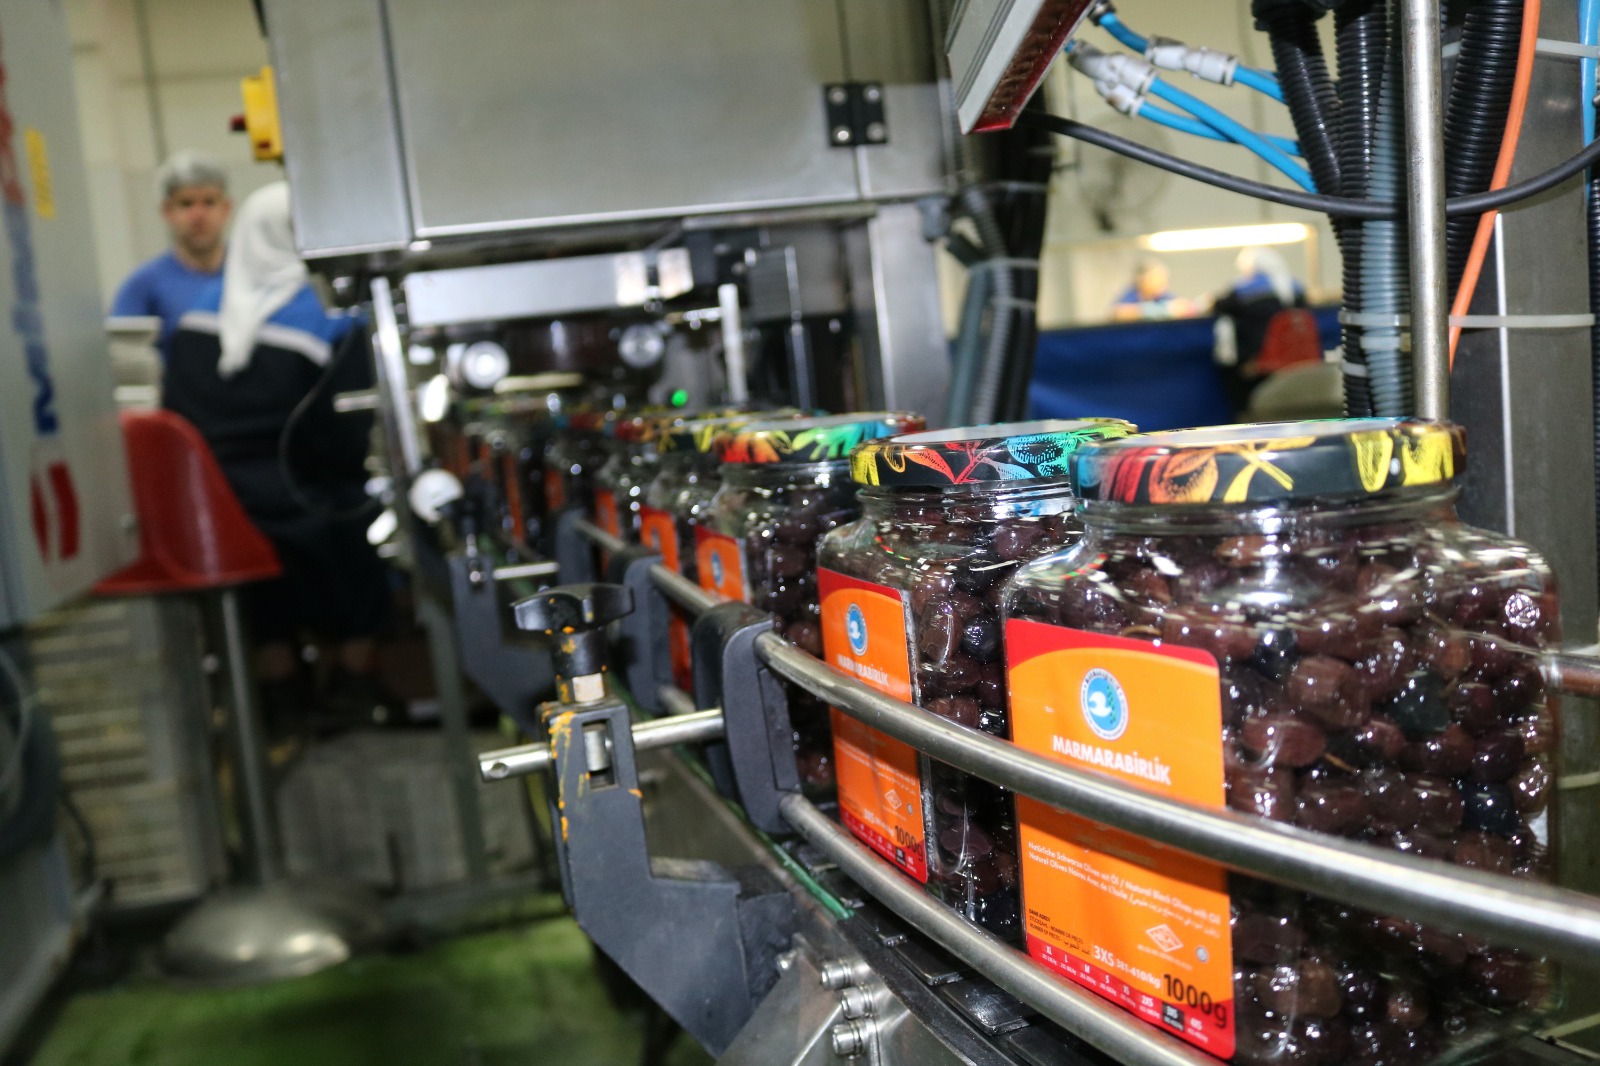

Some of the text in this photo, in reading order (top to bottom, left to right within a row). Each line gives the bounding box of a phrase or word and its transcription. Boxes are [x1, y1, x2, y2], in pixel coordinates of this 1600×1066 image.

[1053, 735, 1172, 785] MARMARABİRLİK
[895, 825, 924, 862] 1000g
[1094, 944, 1115, 967] 3XS
[1116, 961, 1161, 989] 381-410/kg
[1163, 973, 1227, 1029] 1000g
